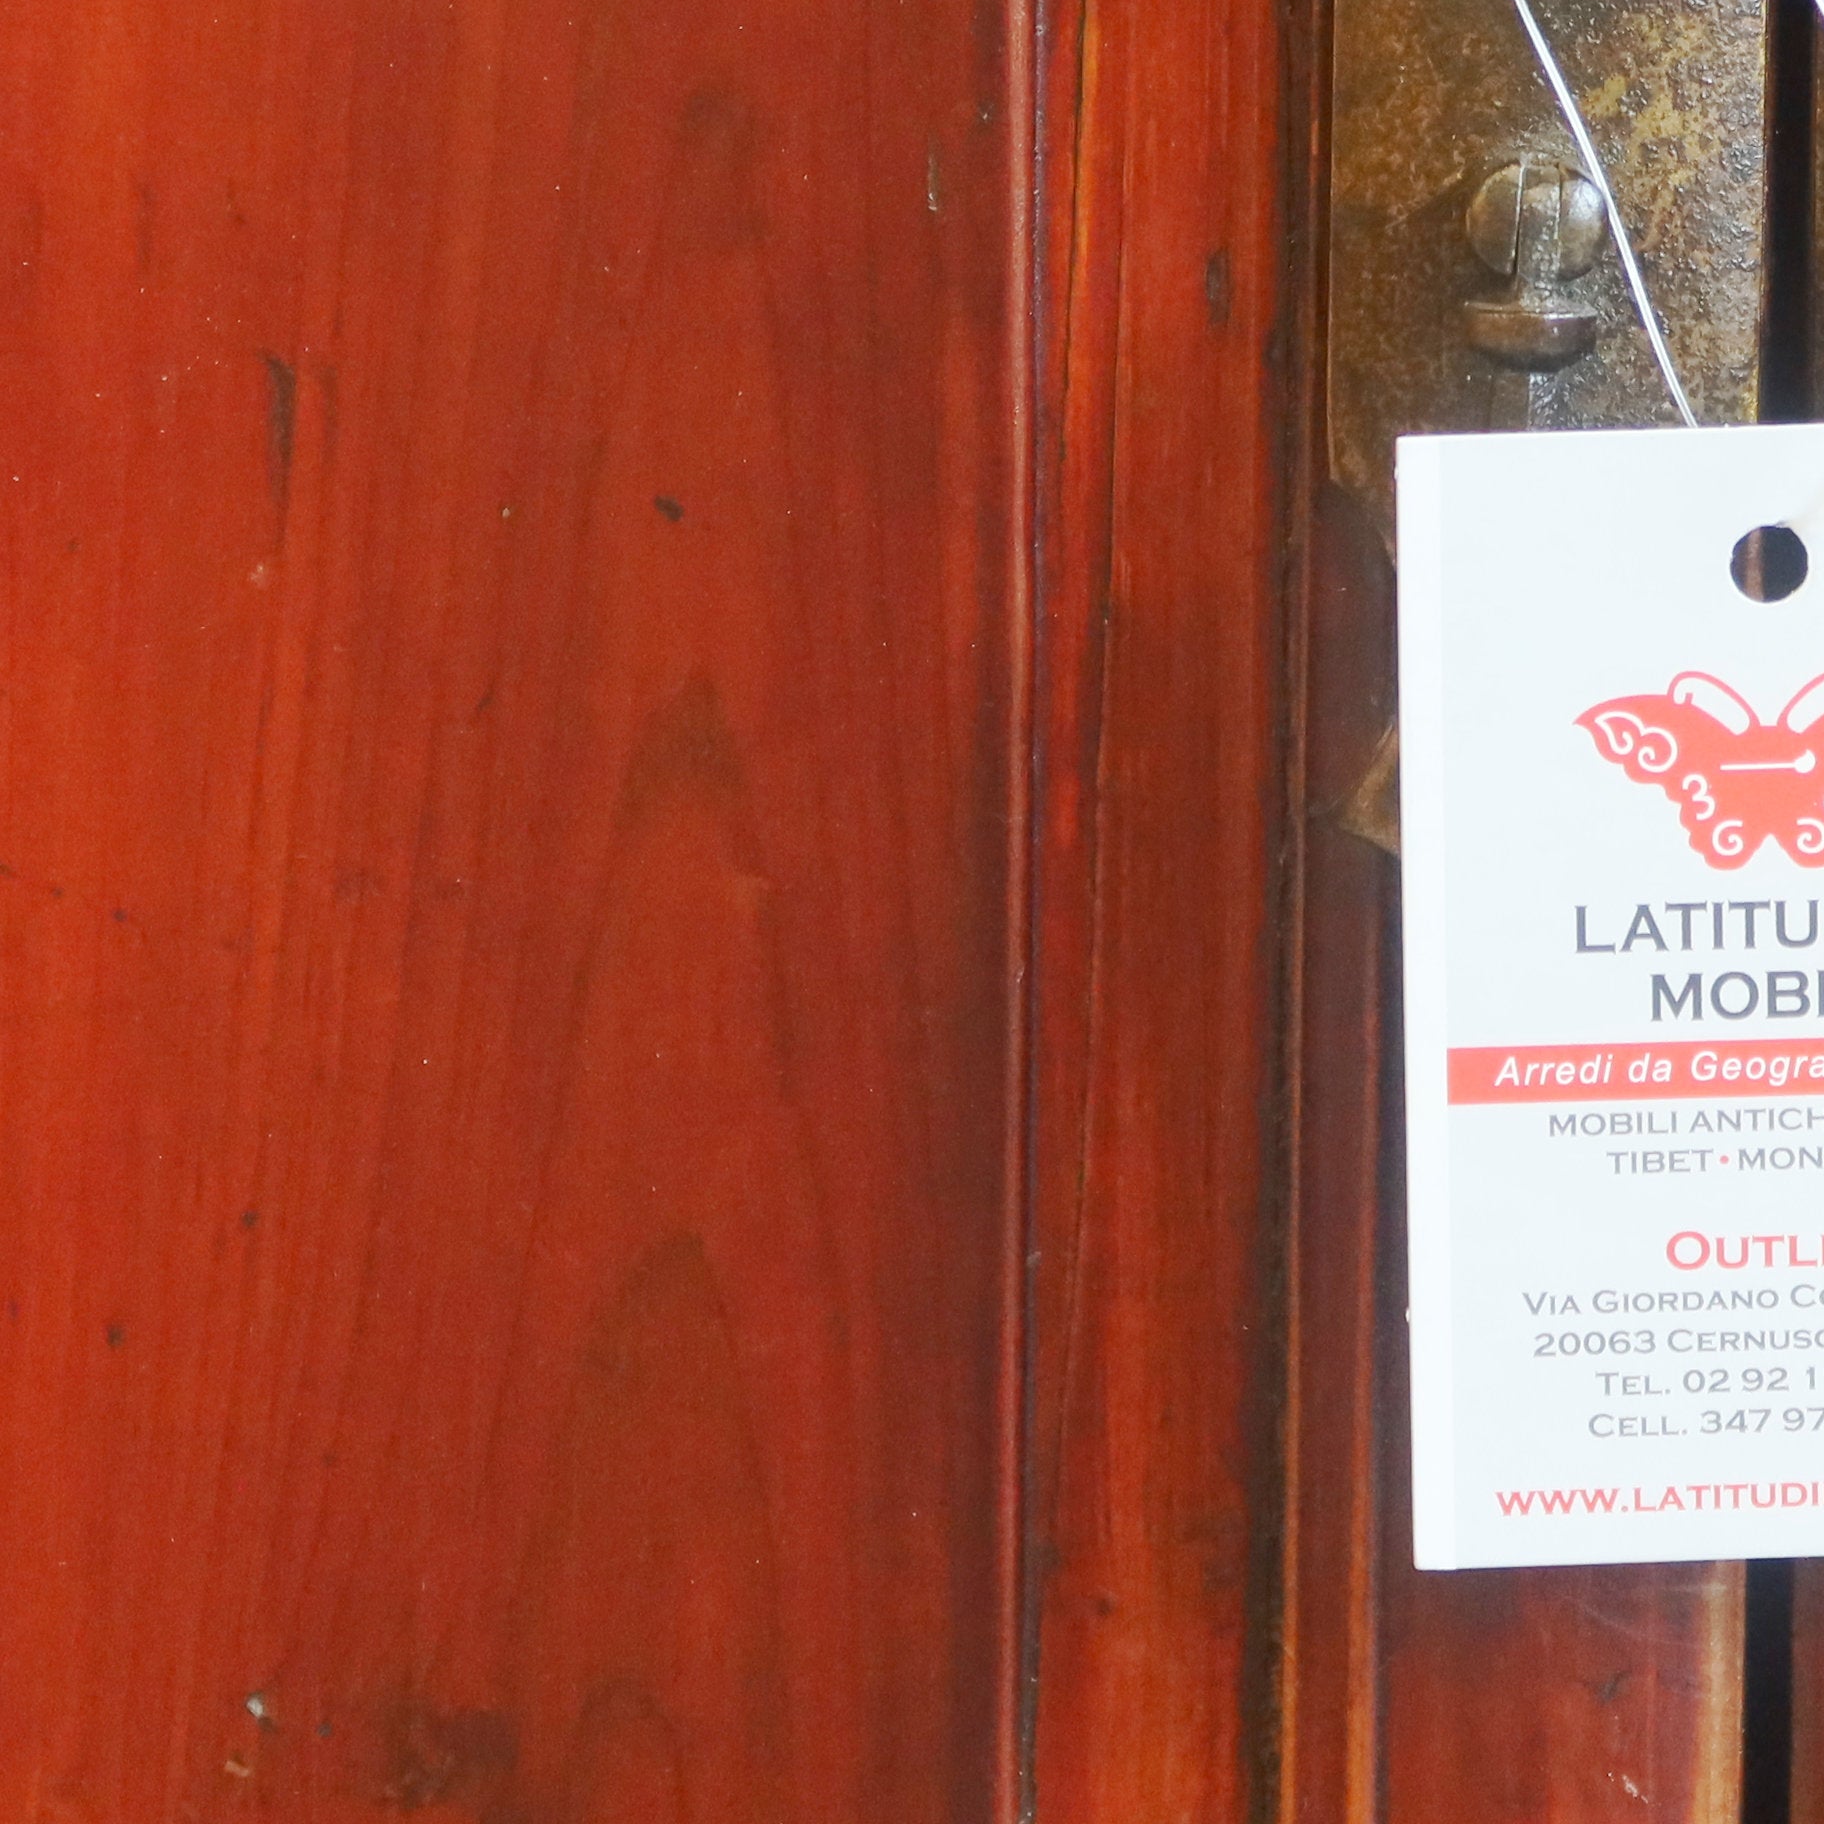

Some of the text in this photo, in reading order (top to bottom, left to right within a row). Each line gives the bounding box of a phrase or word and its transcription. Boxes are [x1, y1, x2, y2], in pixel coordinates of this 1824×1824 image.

[1494, 1053, 1614, 1087] Arredi
[1627, 1052, 1673, 1084] da
[1549, 1111, 1677, 1137] MOBILI
[1606, 1148, 1714, 1175] TIBET
[1521, 1291, 1582, 1316] VIA
[1591, 1288, 1780, 1314] GIORDANO
[1533, 1329, 1657, 1358] 20063
[1595, 1371, 1671, 1397] TEL.
[1682, 1368, 1731, 1394] 02
[1741, 1366, 1790, 1393] 92
[1588, 1413, 1688, 1439] CELL.
[1699, 1408, 1772, 1434] 347
